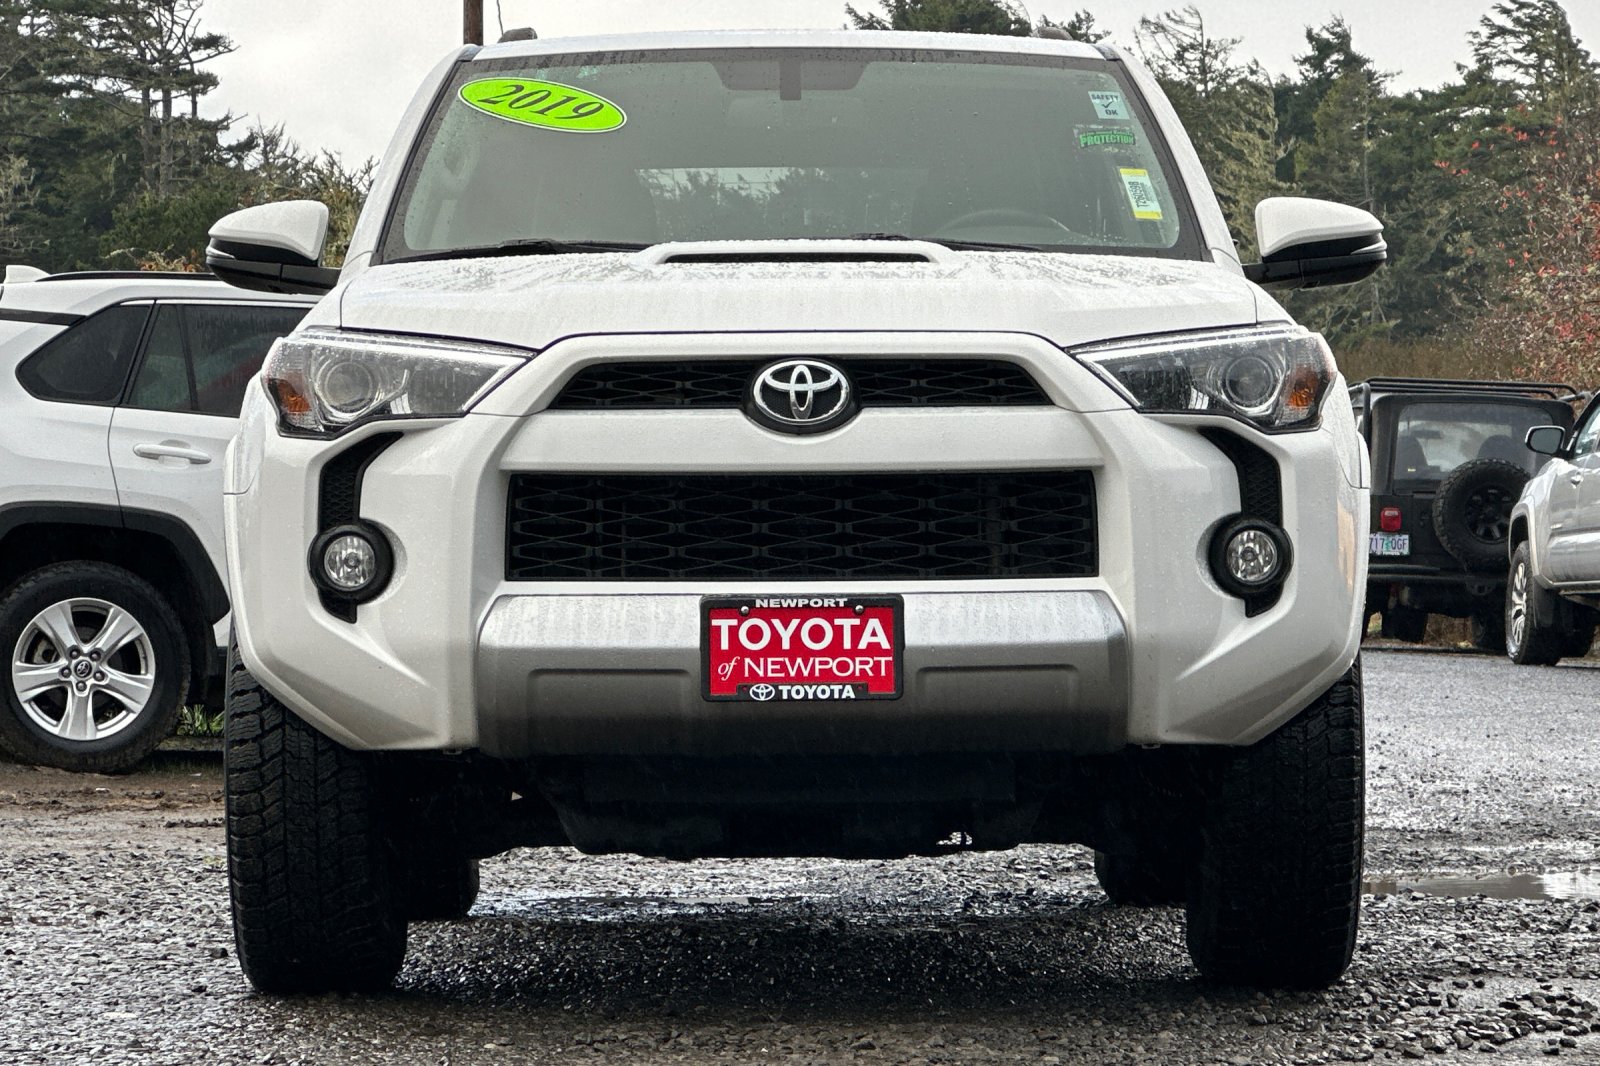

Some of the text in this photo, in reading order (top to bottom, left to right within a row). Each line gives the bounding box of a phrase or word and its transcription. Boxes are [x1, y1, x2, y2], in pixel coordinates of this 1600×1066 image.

[477, 84, 604, 120] 2019
[1079, 133, 1133, 148] PROTECTION
[755, 598, 848, 608] NEWPORT
[711, 617, 891, 650] TOYOTA
[717, 656, 893, 681] of NEWPORT
[778, 685, 856, 700] TOYOTA
